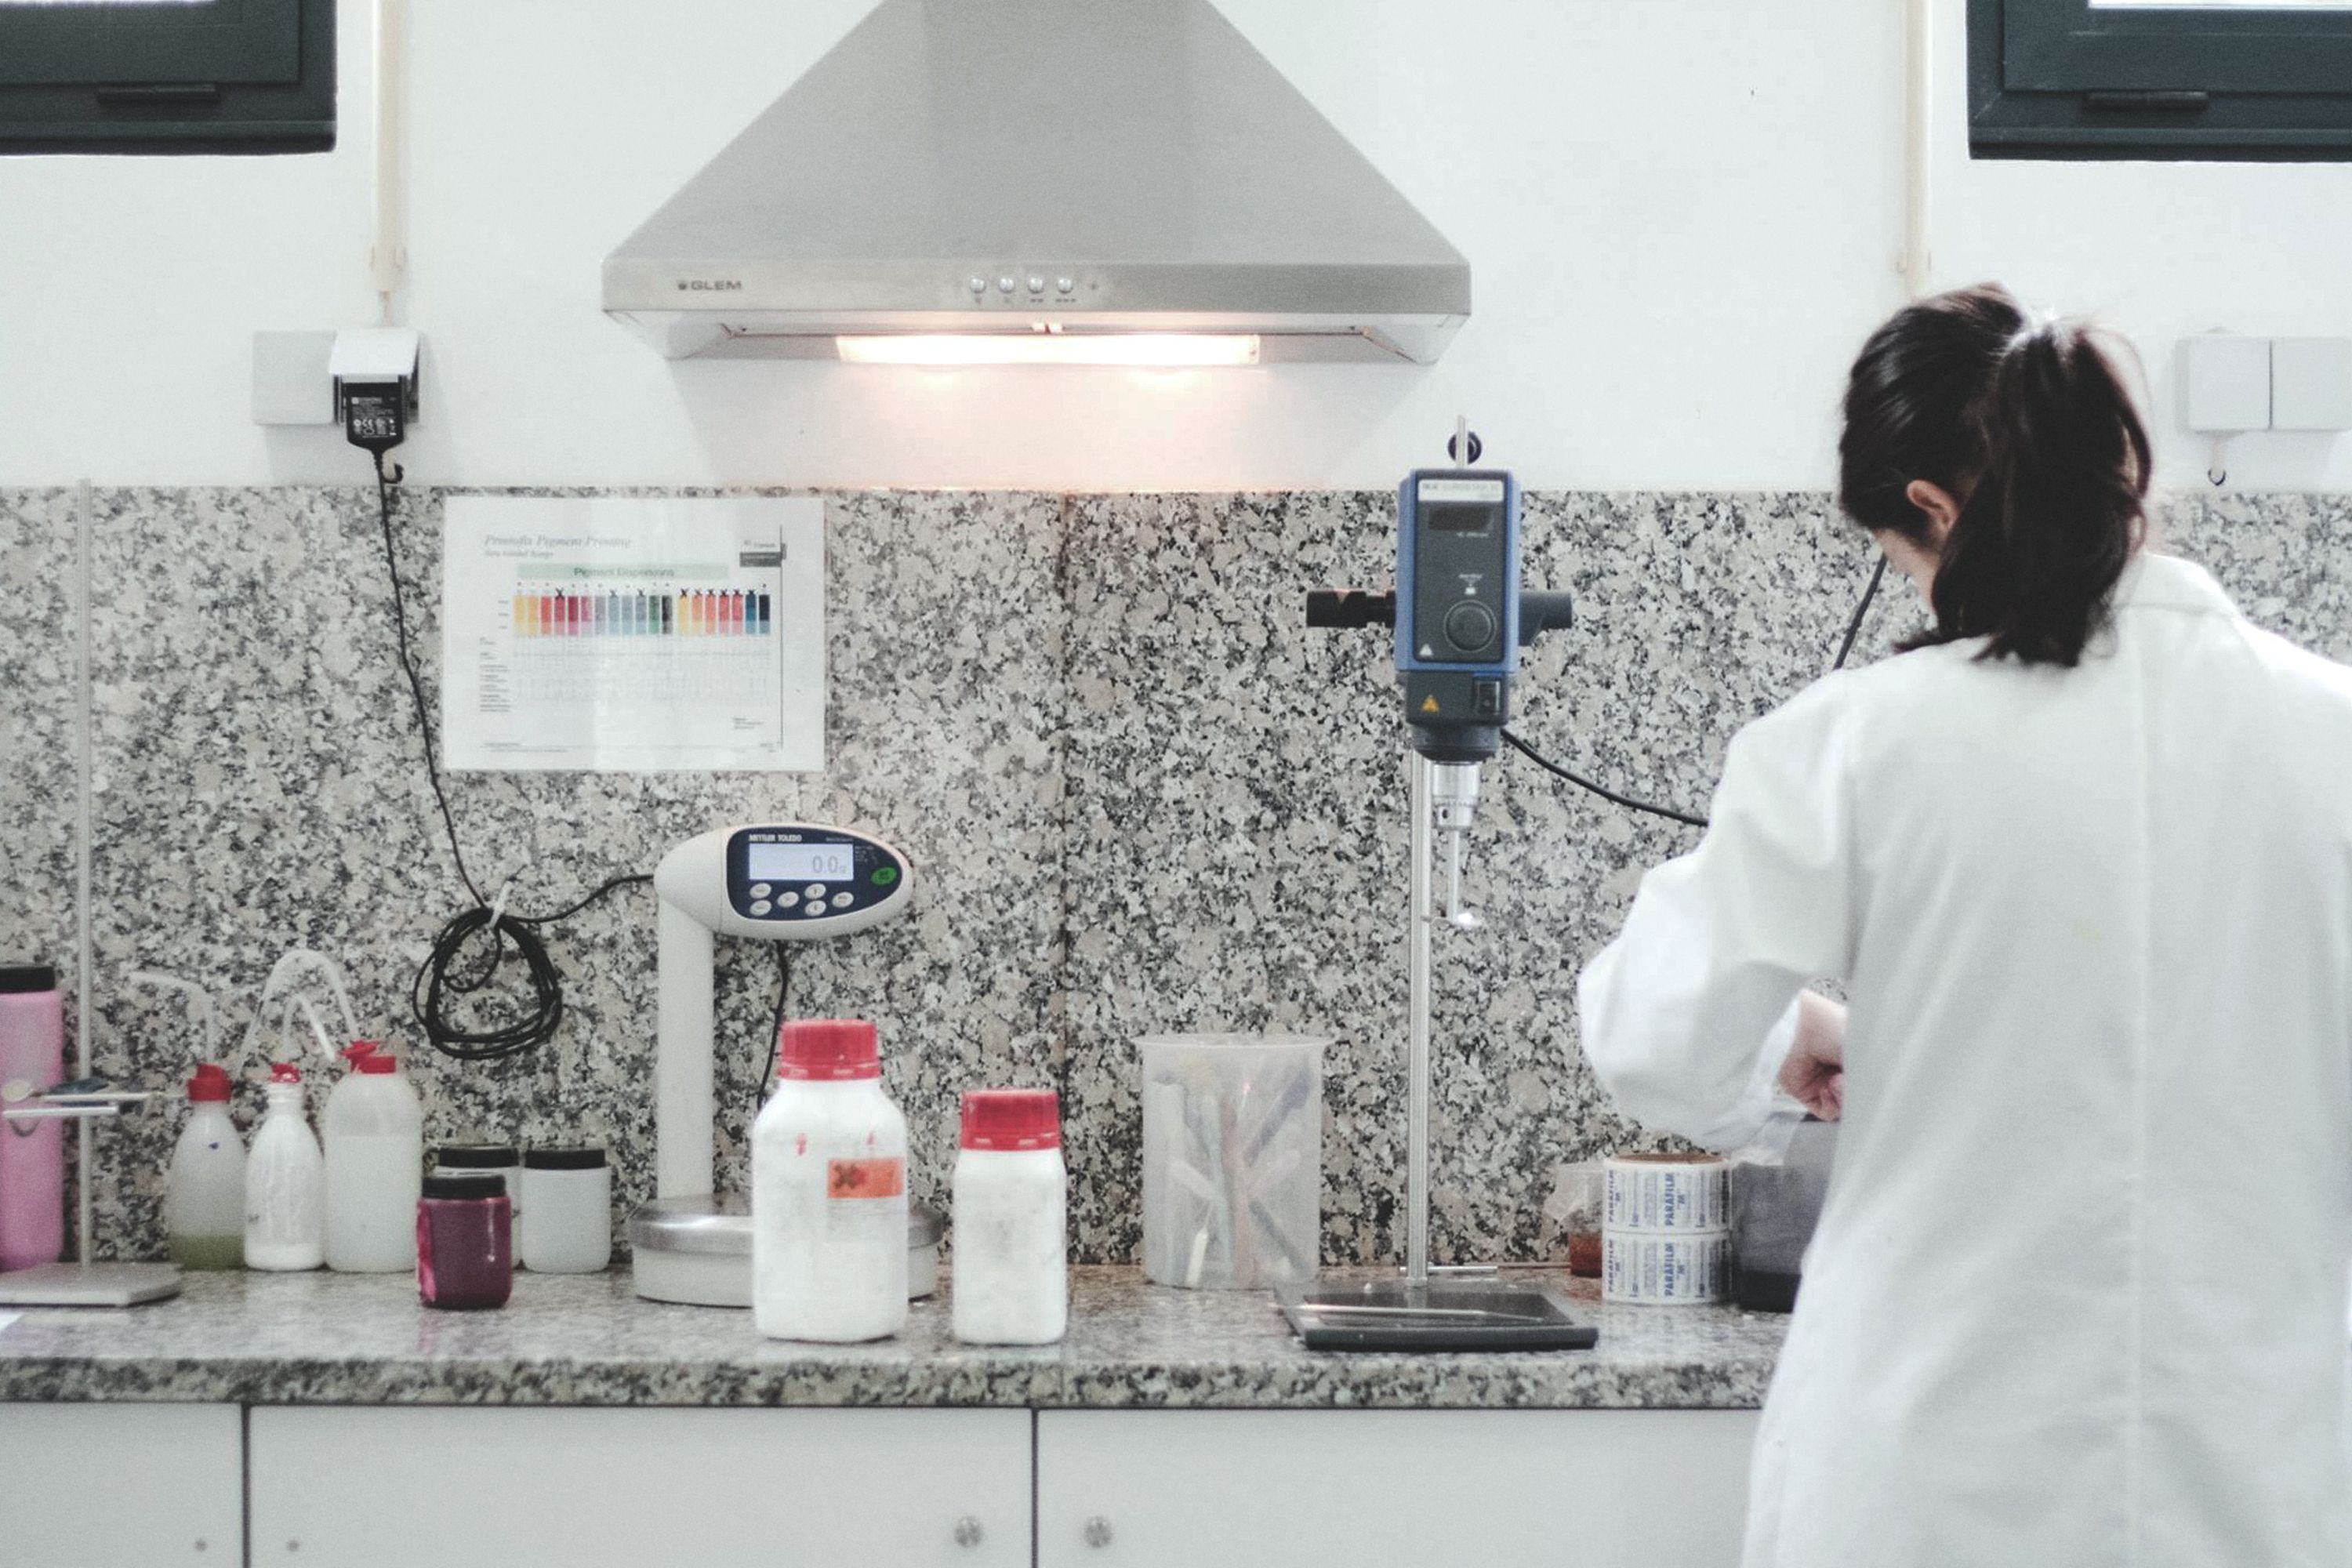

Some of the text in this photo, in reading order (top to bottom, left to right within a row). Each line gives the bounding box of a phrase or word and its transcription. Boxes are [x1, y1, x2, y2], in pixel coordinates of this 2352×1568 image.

[691, 280, 742, 290] GLEM
[1664, 1173, 1675, 1226] PARAFILM
[1664, 1243, 1674, 1297] PARAFILM
